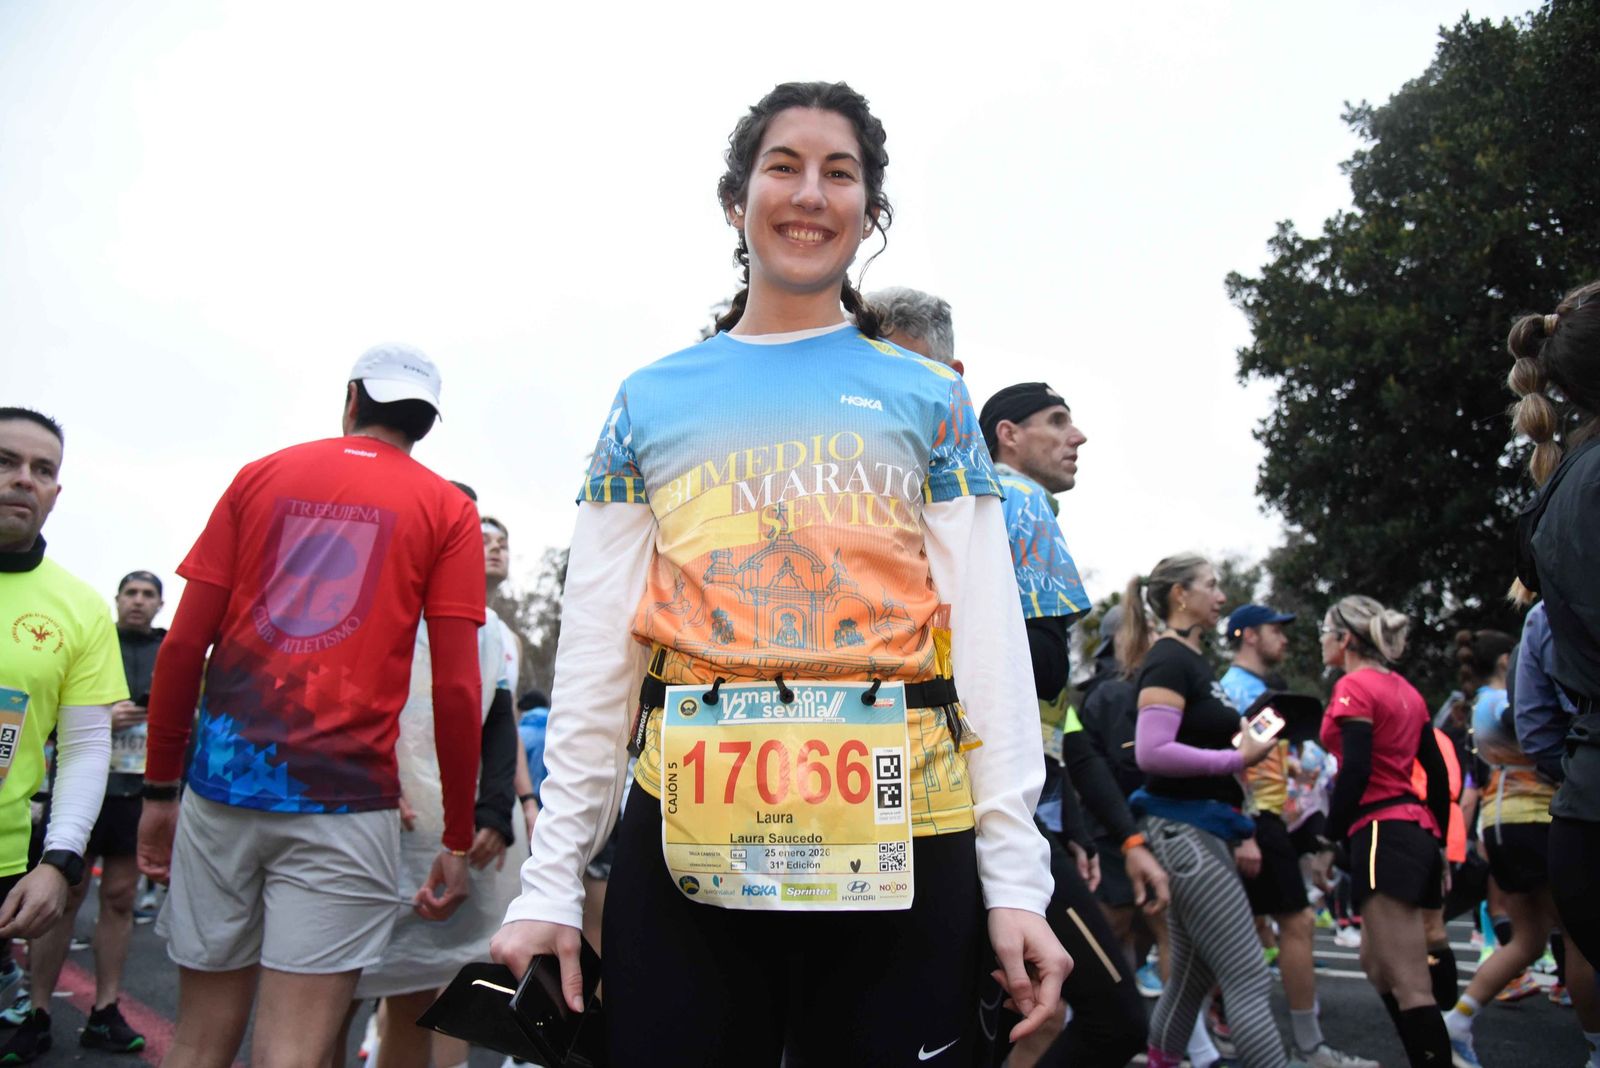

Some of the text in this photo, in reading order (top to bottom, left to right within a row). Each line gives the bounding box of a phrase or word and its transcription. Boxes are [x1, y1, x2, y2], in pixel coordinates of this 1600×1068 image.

[840, 394, 884, 412] HOKA
[703, 431, 865, 489] MEDIO
[734, 460, 924, 515] MARATÓ
[288, 500, 381, 523] TREBUJENA
[741, 687, 828, 704] martón
[762, 700, 827, 718] sevilla
[682, 739, 872, 806] 17066
[666, 761, 678, 815] CAJÓN 5
[756, 811, 794, 825] Laura
[730, 832, 823, 845] Laura Saucedo
[764, 848, 831, 858] 25 enero 2026
[786, 860, 821, 870] Edición
[741, 884, 777, 896] HOKA
[786, 886, 832, 897] Sprinter
